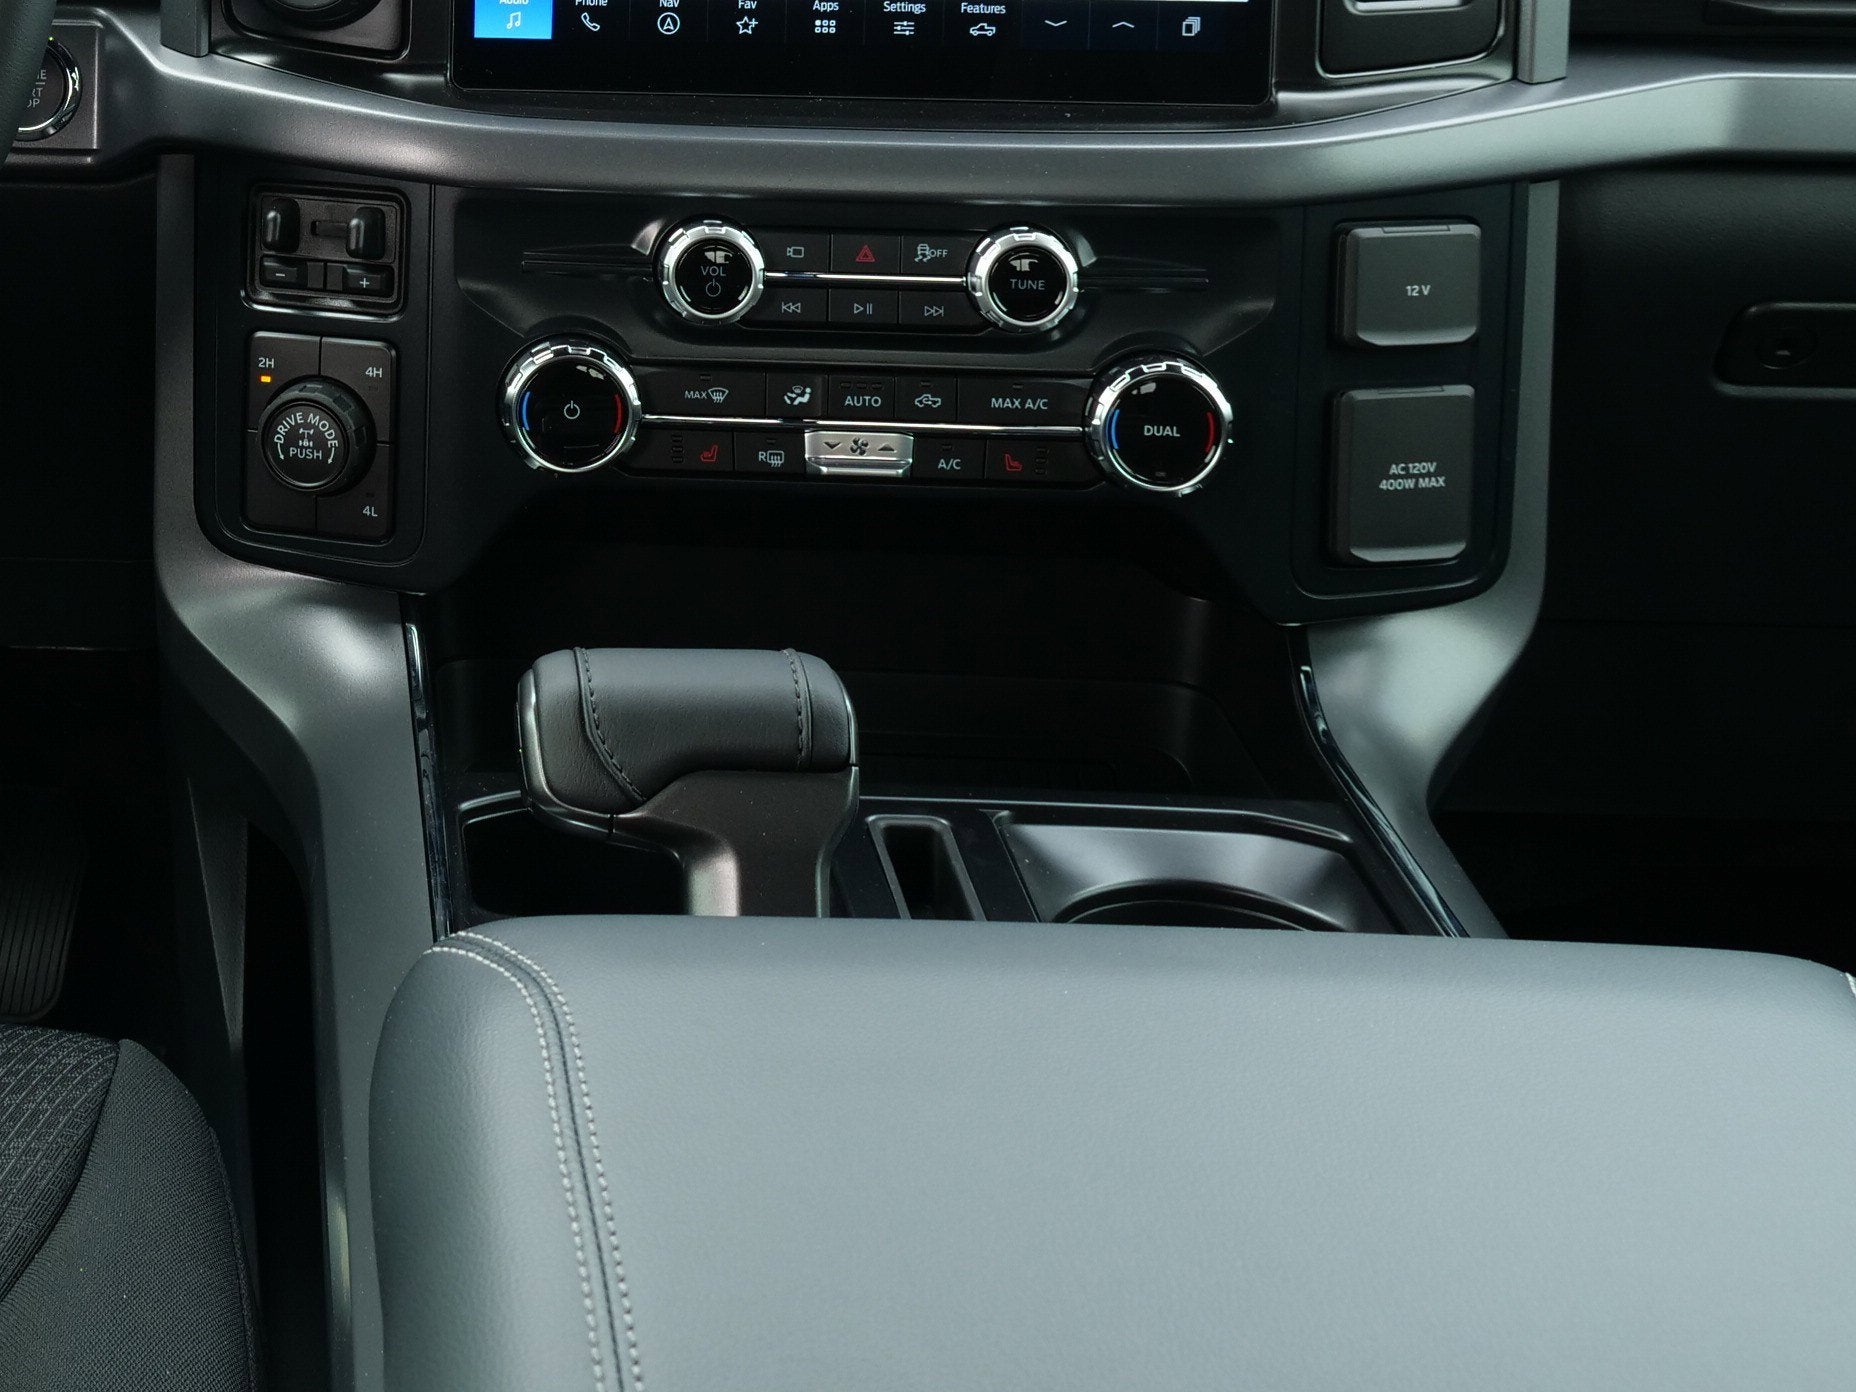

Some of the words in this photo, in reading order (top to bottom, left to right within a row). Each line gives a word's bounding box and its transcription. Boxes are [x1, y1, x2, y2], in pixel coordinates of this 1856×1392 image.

[813, 0, 839, 12] Apps
[883, 1, 926, 13] Settings
[960, 2, 1006, 14] Features
[929, 249, 948, 258] OFF
[701, 266, 726, 277] VOL
[1010, 278, 1045, 291] TUNE
[1406, 285, 1420, 296] 12
[1422, 285, 1431, 296] V
[258, 358, 275, 368] 2H
[365, 366, 383, 377] 4H
[685, 390, 707, 400] MAX
[845, 396, 882, 407] AUTO
[991, 398, 1021, 409] MAX
[1025, 399, 1048, 410] A/C
[274, 412, 304, 444] DRIVE
[307, 413, 338, 448] MODE
[1144, 425, 1181, 437] DUAL
[289, 446, 322, 460] PUSH
[937, 459, 962, 470] A/C
[1389, 464, 1406, 475] AC
[1408, 462, 1437, 473] 120V
[1379, 479, 1416, 490] 400W
[1418, 476, 1445, 488] MAX
[362, 505, 378, 516] 4L
